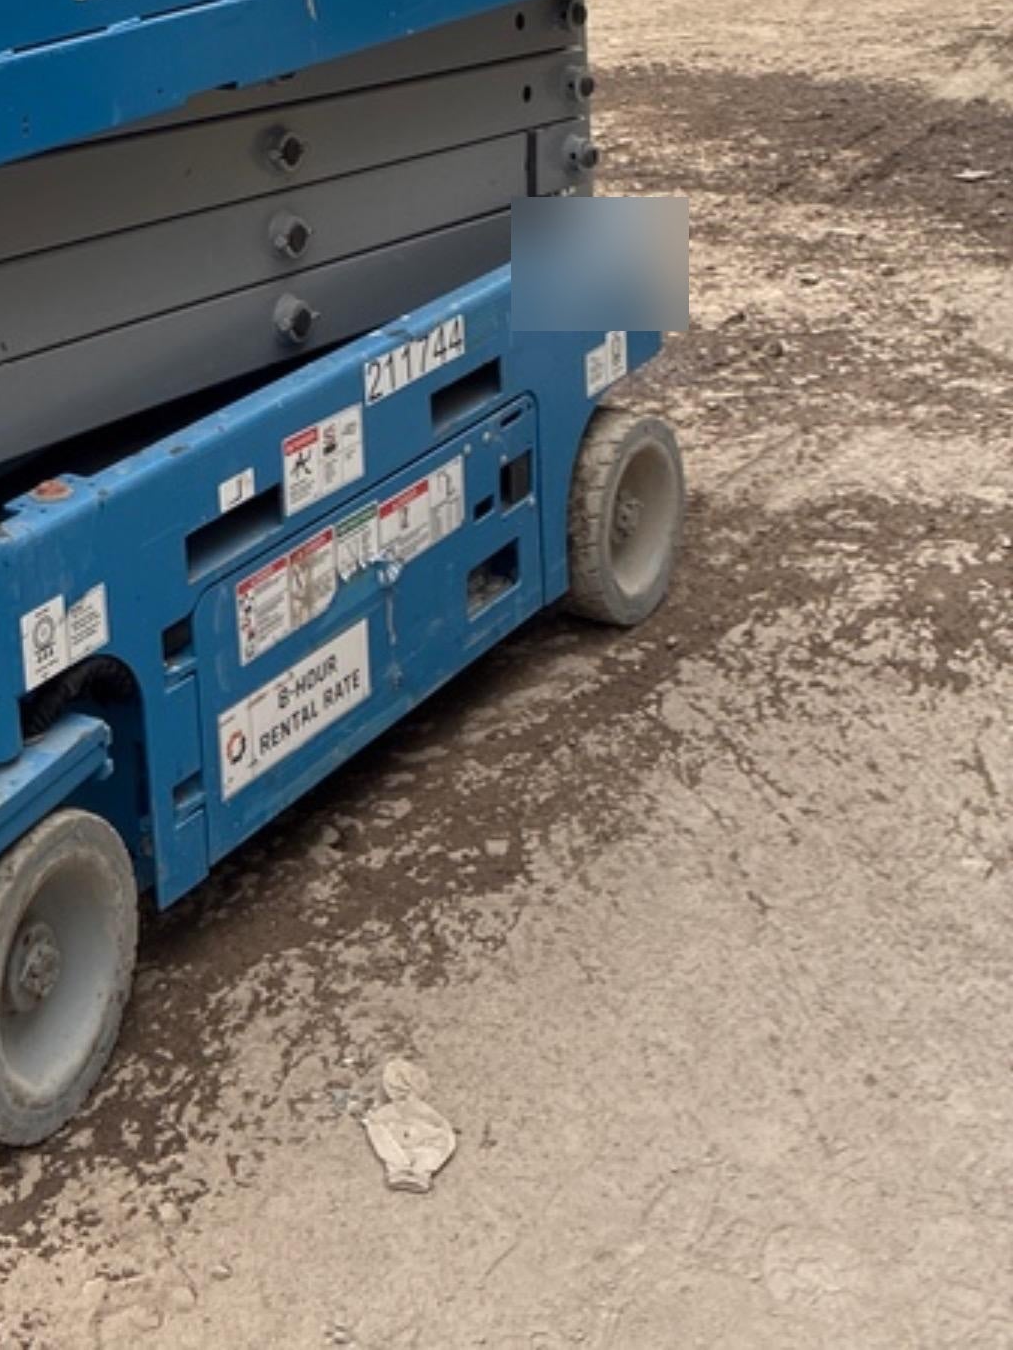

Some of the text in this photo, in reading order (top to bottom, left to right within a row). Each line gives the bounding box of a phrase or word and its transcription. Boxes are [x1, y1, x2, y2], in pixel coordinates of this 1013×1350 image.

[367, 319, 463, 402] 211744
[258, 700, 319, 755] RENTAL
[323, 667, 361, 708] RATE
